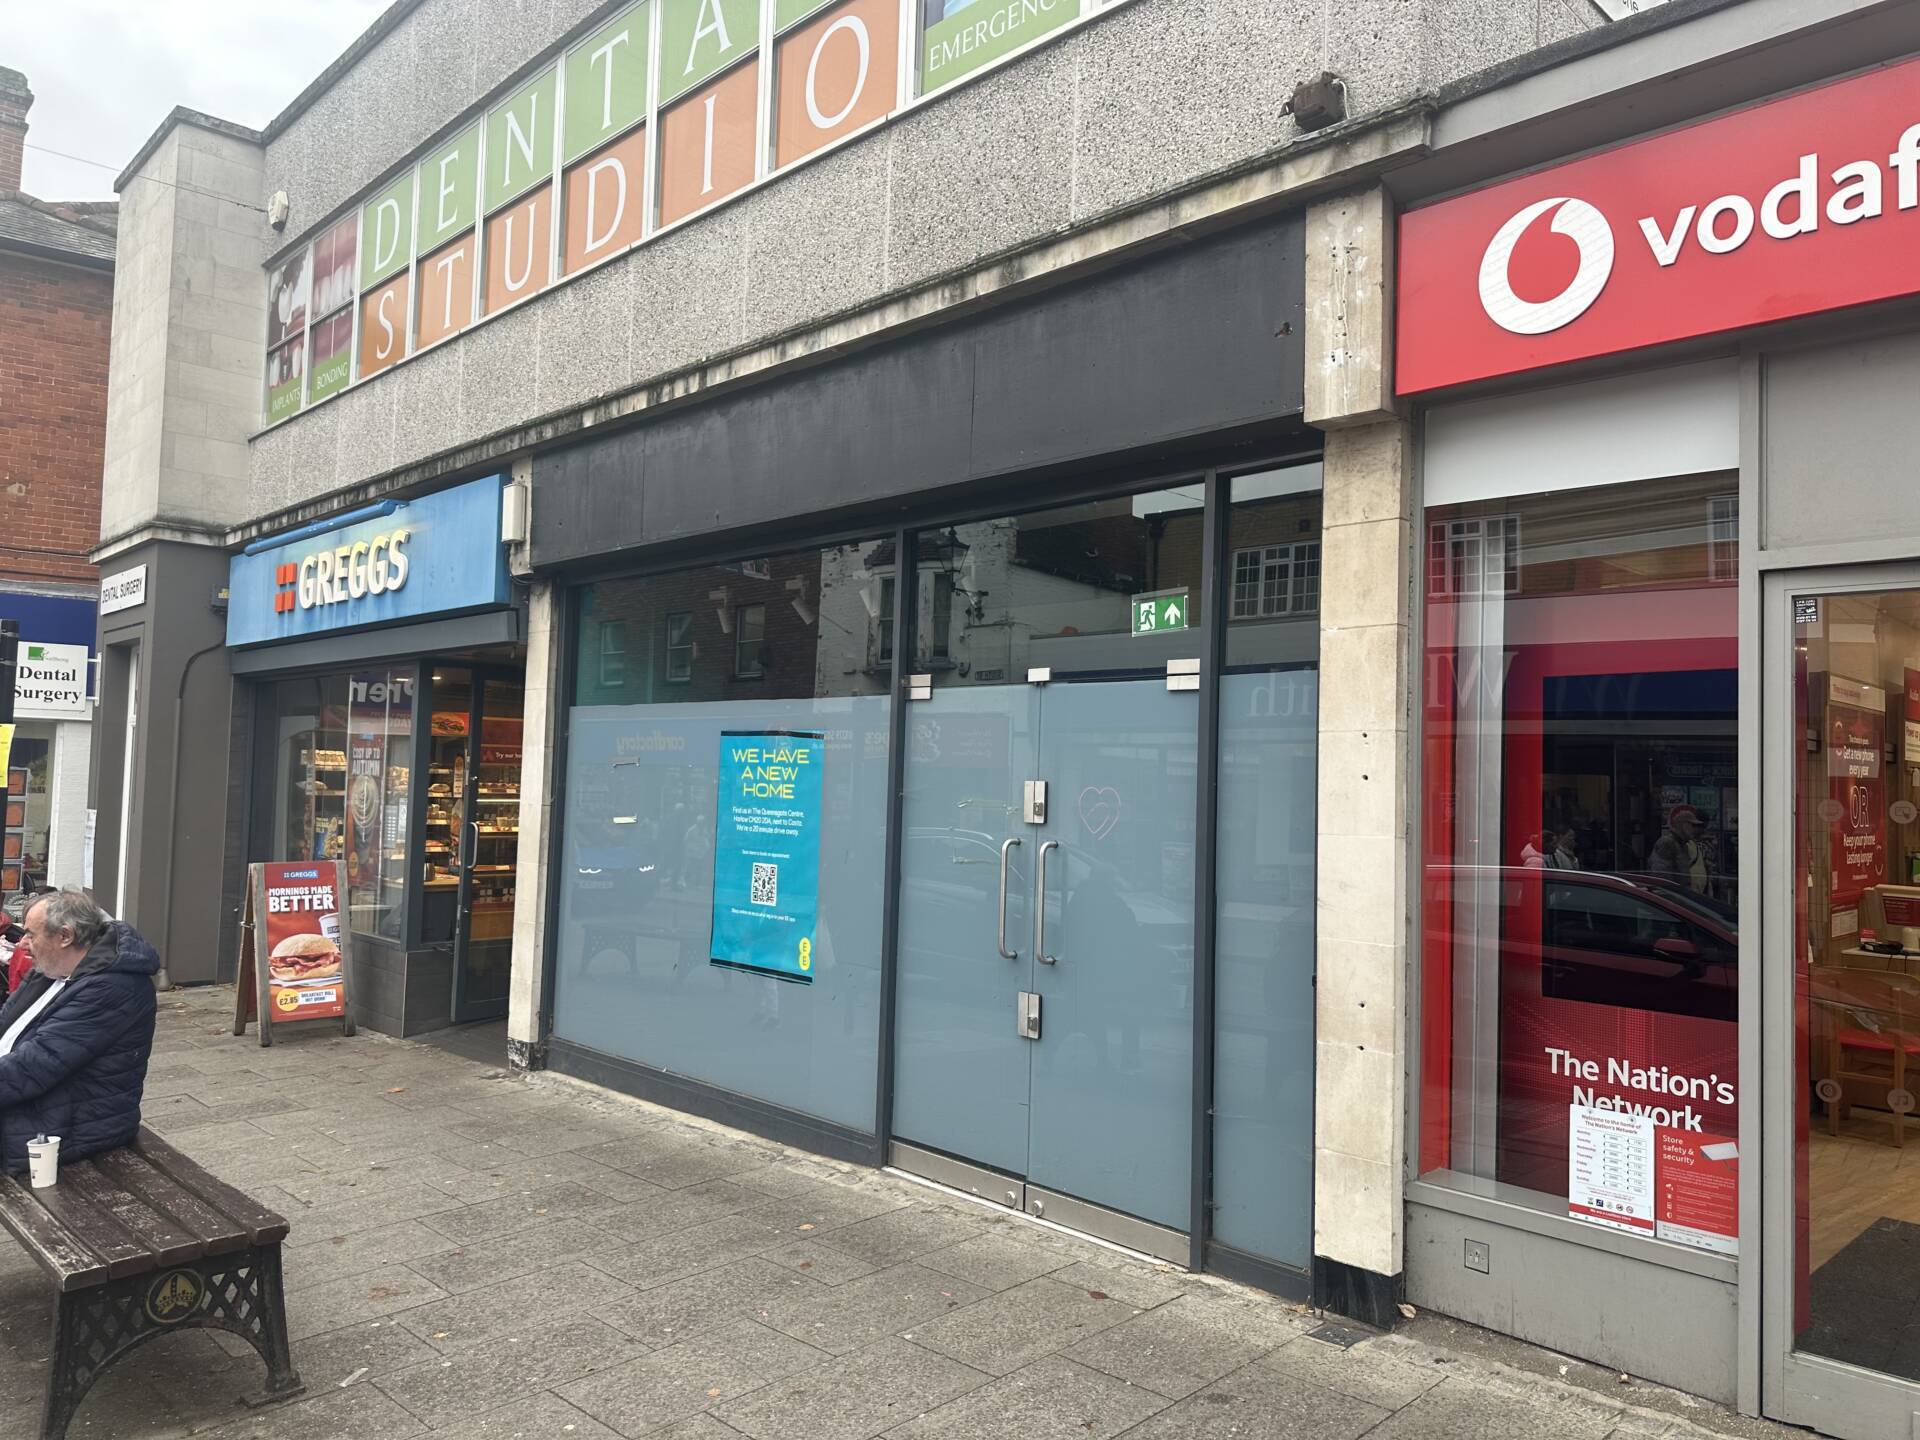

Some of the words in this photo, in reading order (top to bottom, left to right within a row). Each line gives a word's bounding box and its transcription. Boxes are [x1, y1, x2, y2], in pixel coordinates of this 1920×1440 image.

[929, 0, 1058, 72] EMERGEN
[376, 15, 870, 360] STUDIO
[317, 362, 348, 390] BONDING
[272, 386, 301, 412] IMPLANTS
[298, 528, 411, 610] GREGGS
[102, 585, 119, 604] DENTAL
[119, 577, 143, 598] SURGERY
[19, 666, 76, 681] Dental
[14, 685, 82, 704] Surgery
[352, 747, 365, 759] COSY
[366, 747, 373, 759] UP
[373, 747, 381, 759] TO
[732, 748, 759, 763] WE
[763, 748, 810, 764] HAVE
[352, 760, 380, 776] AUTUMN
[741, 766, 754, 780] A
[757, 766, 798, 781] NEW
[743, 783, 795, 799] HOME
[1850, 785, 1870, 828] OR
[290, 871, 317, 879] GREGGS
[268, 886, 309, 896] MORNINGS
[310, 885, 333, 895] MADE
[269, 894, 335, 913] BETTER
[279, 996, 299, 1006] £2.85
[1544, 1047, 1599, 1081] The
[1607, 1057, 1735, 1105] Nation's
[1573, 1085, 1703, 1133] Network
[1581, 1114, 1604, 1124] Welcome
[1662, 1135, 1683, 1145] Store
[1663, 1144, 1687, 1156] safety
[1688, 1148, 1695, 1156] &
[1663, 1153, 1695, 1166] security
